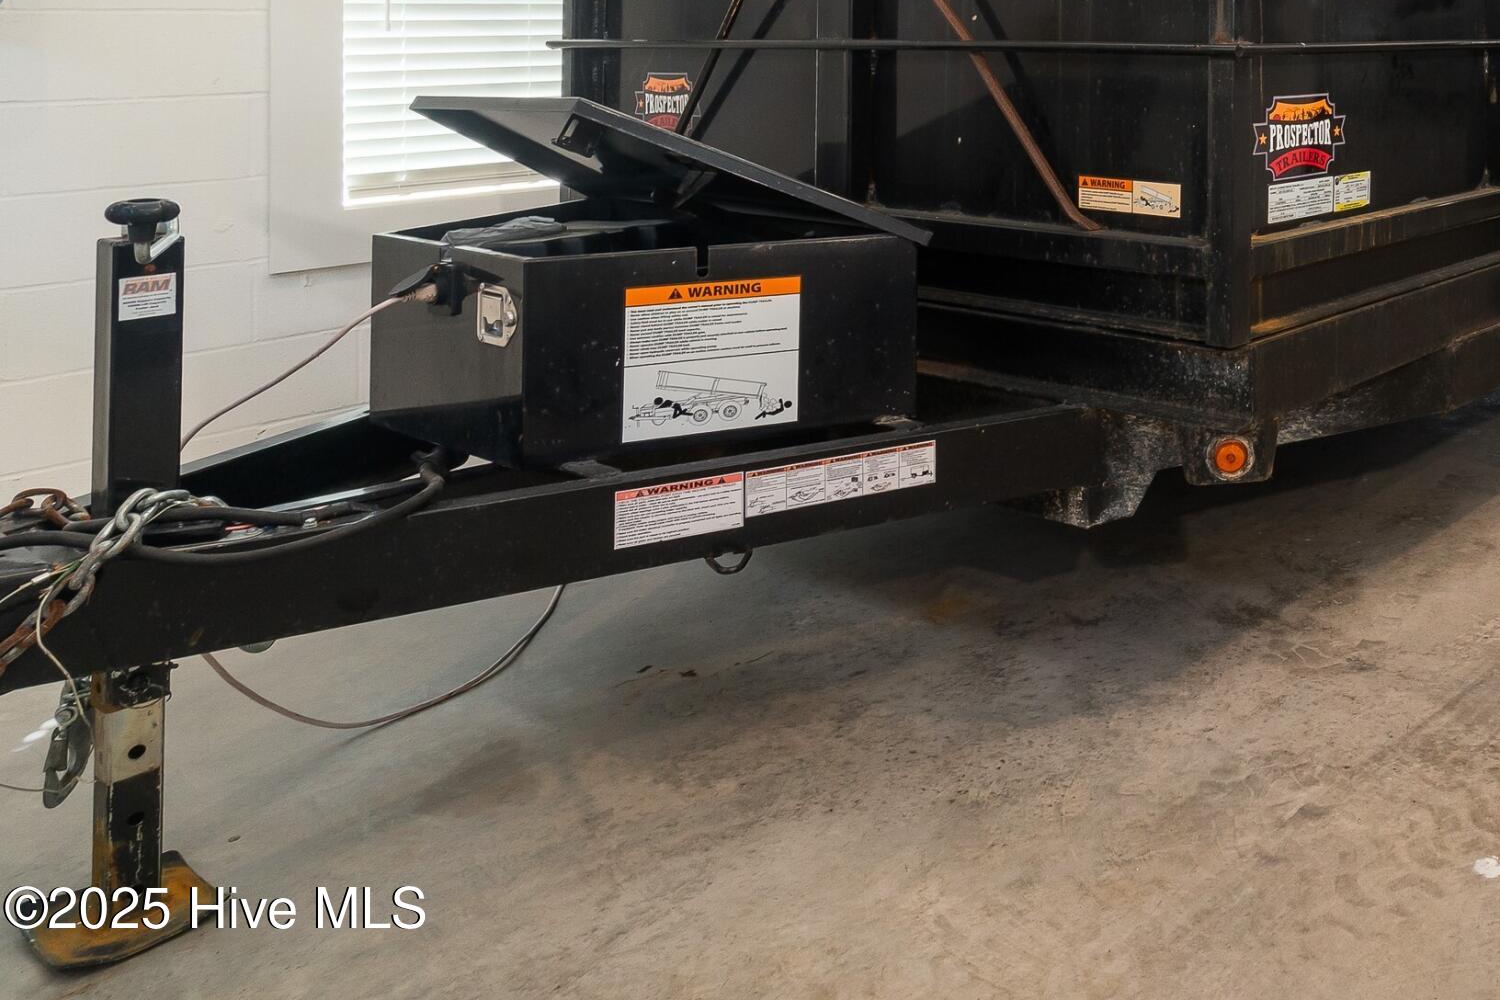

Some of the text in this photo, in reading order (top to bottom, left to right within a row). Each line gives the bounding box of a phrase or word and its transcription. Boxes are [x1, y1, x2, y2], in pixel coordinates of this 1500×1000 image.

[1269, 118, 1332, 153] PROSPECTOR
[1276, 151, 1326, 171] TRAILERS
[1090, 178, 1126, 189] WARNING
[688, 282, 762, 299] WARNING
[647, 478, 714, 496] WARNING
